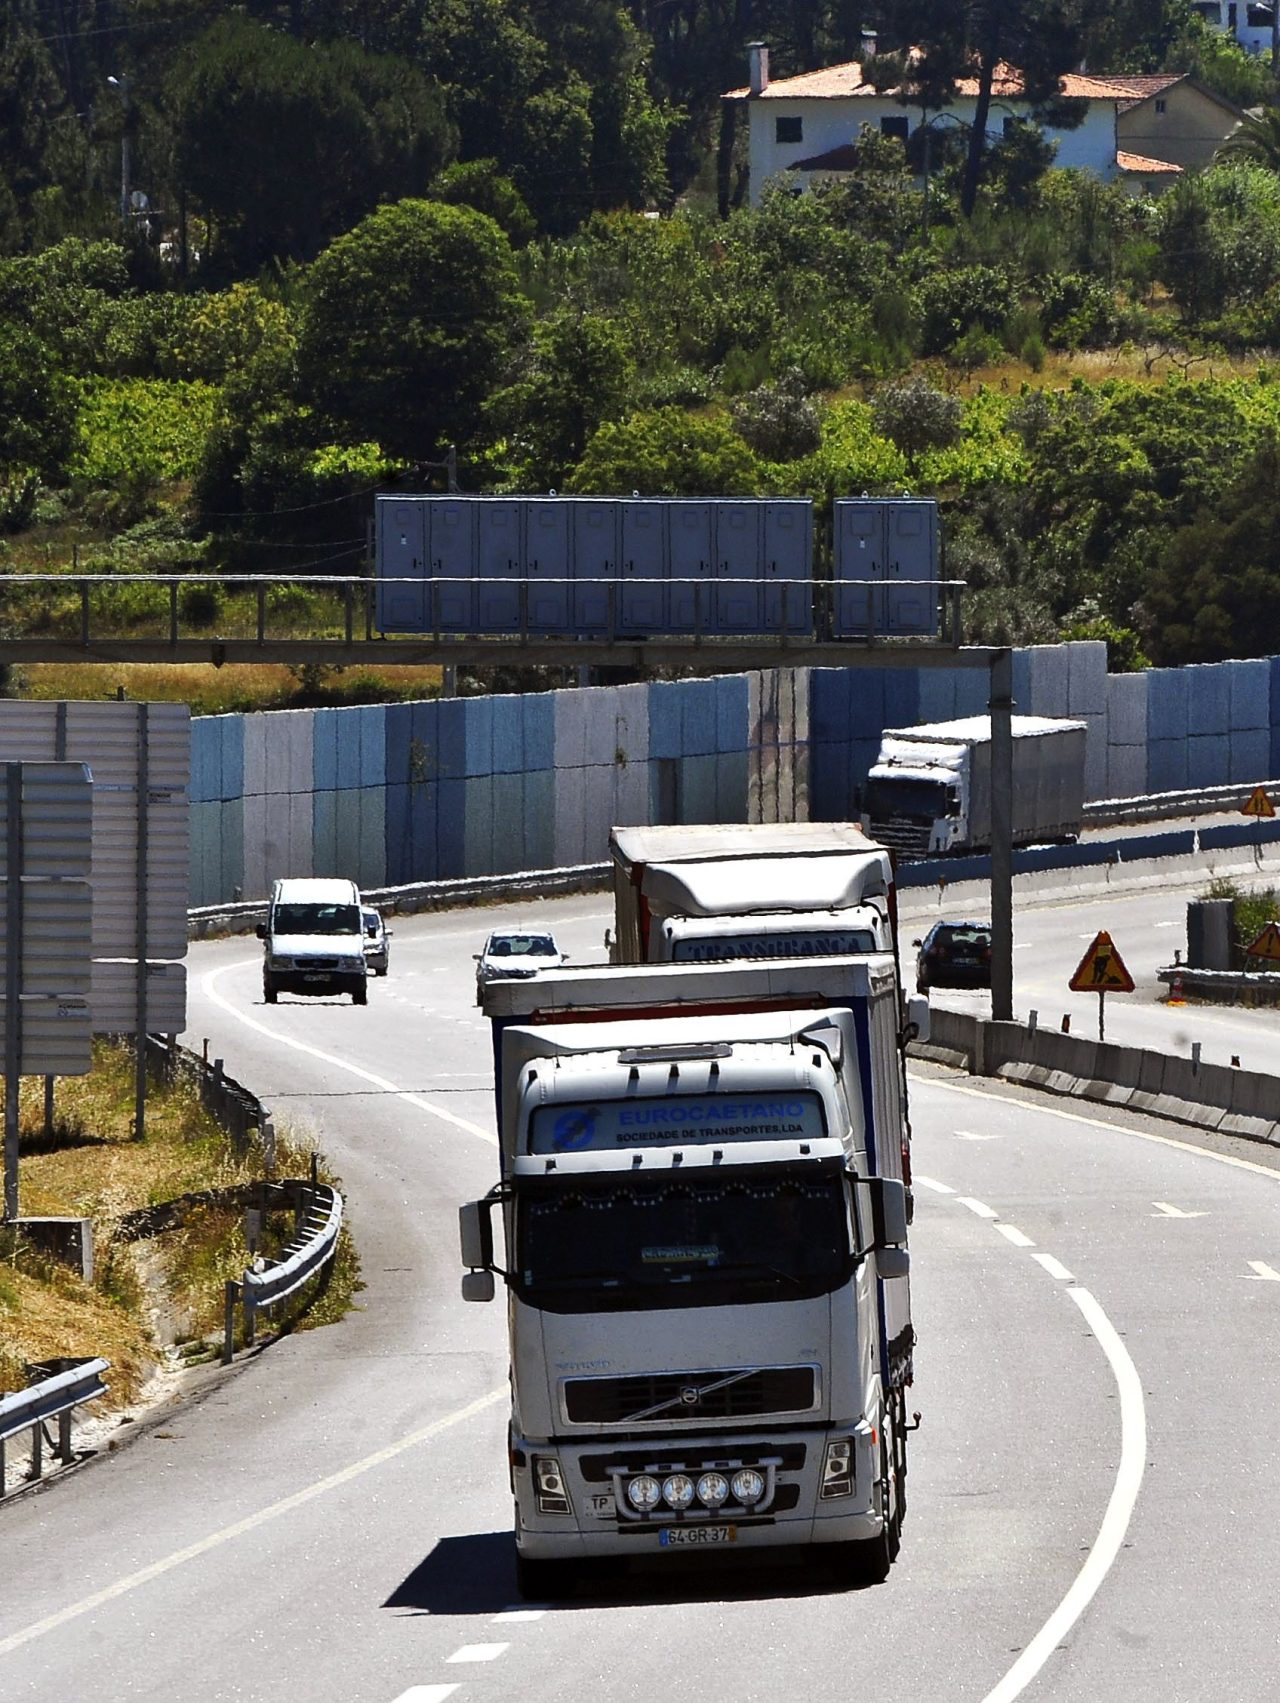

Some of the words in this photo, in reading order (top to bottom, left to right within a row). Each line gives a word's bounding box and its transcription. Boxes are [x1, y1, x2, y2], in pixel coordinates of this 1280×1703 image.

[619, 1103, 805, 1126] EUROCAETANO
[616, 1130, 680, 1143] SOCIEDADE
[682, 1128, 697, 1139] DE
[591, 1497, 609, 1510] TP
